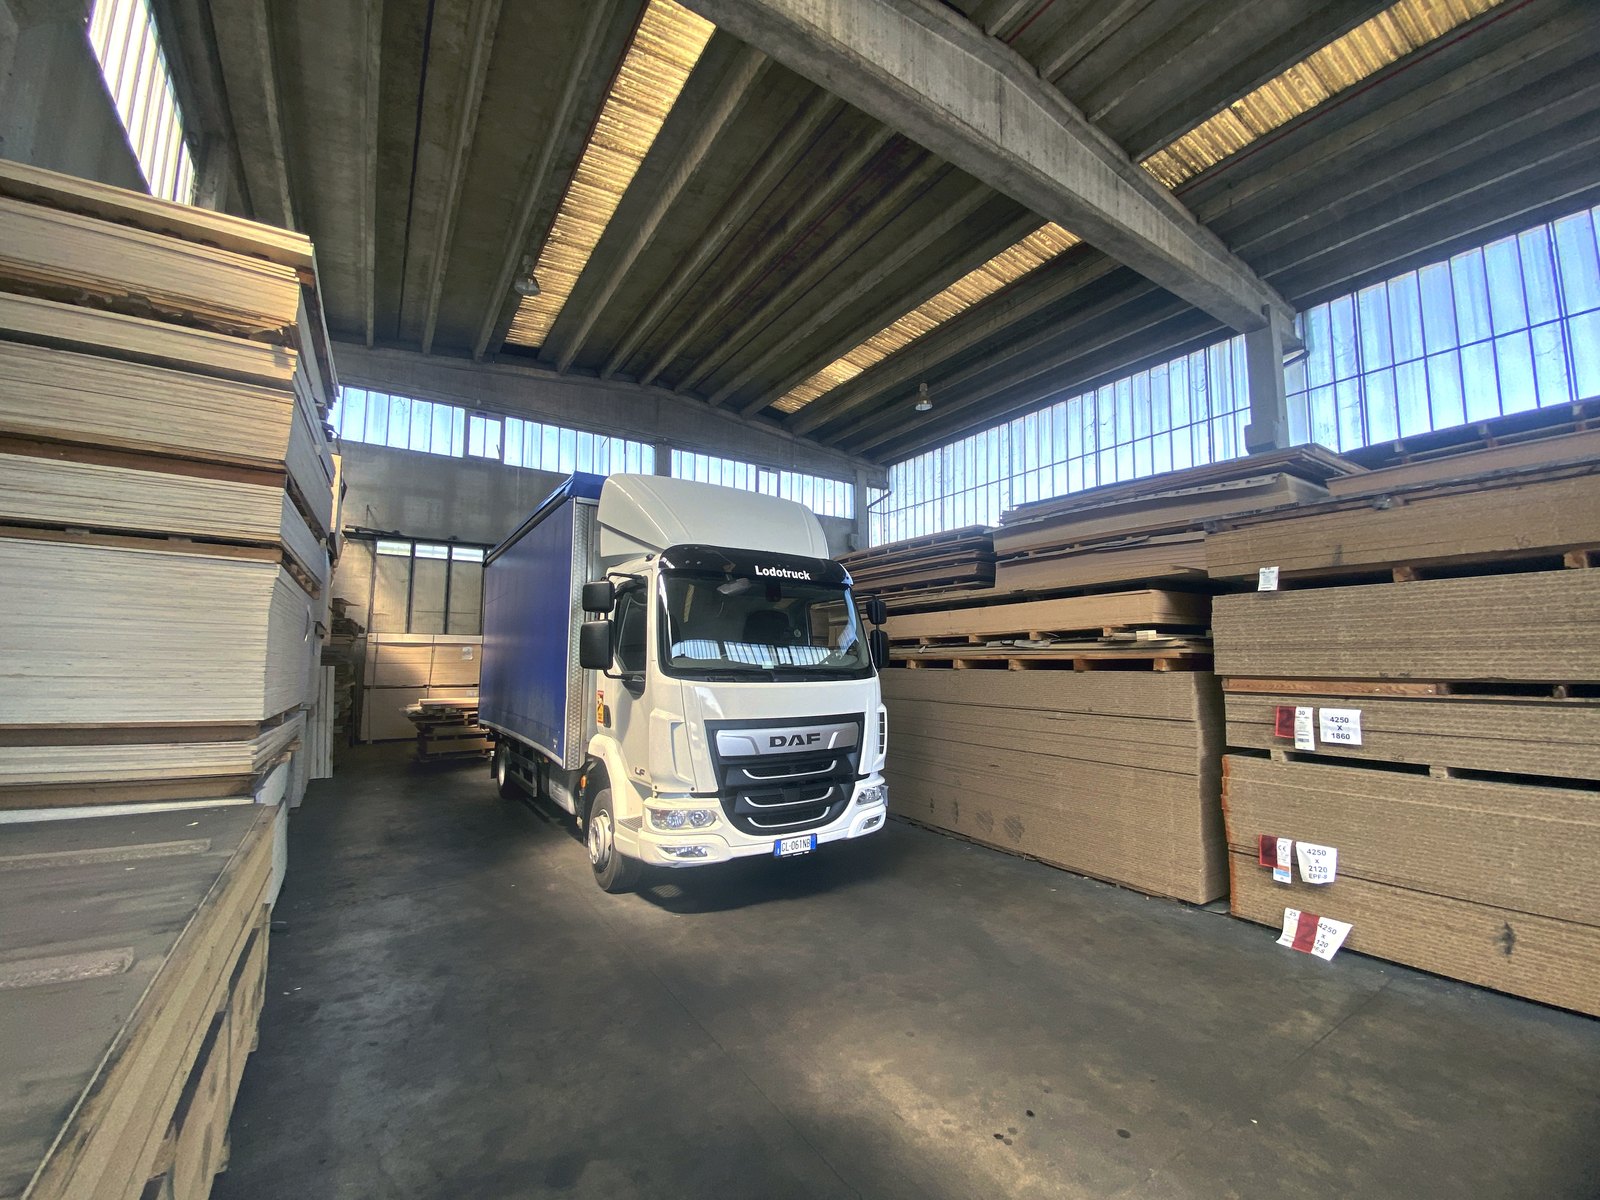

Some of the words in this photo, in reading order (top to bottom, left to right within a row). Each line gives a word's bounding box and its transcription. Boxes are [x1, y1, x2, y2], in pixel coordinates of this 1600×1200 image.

[754, 565, 811, 580] Lodotruck
[1329, 716, 1350, 724] 4250
[769, 732, 821, 748] DAF
[1331, 732, 1351, 740] 1860
[1306, 848, 1327, 857] 4250
[1308, 865, 1328, 873] 2120
[1288, 910, 1297, 918] 25
[1317, 922, 1338, 935] 4250
[1316, 939, 1329, 949] 120
